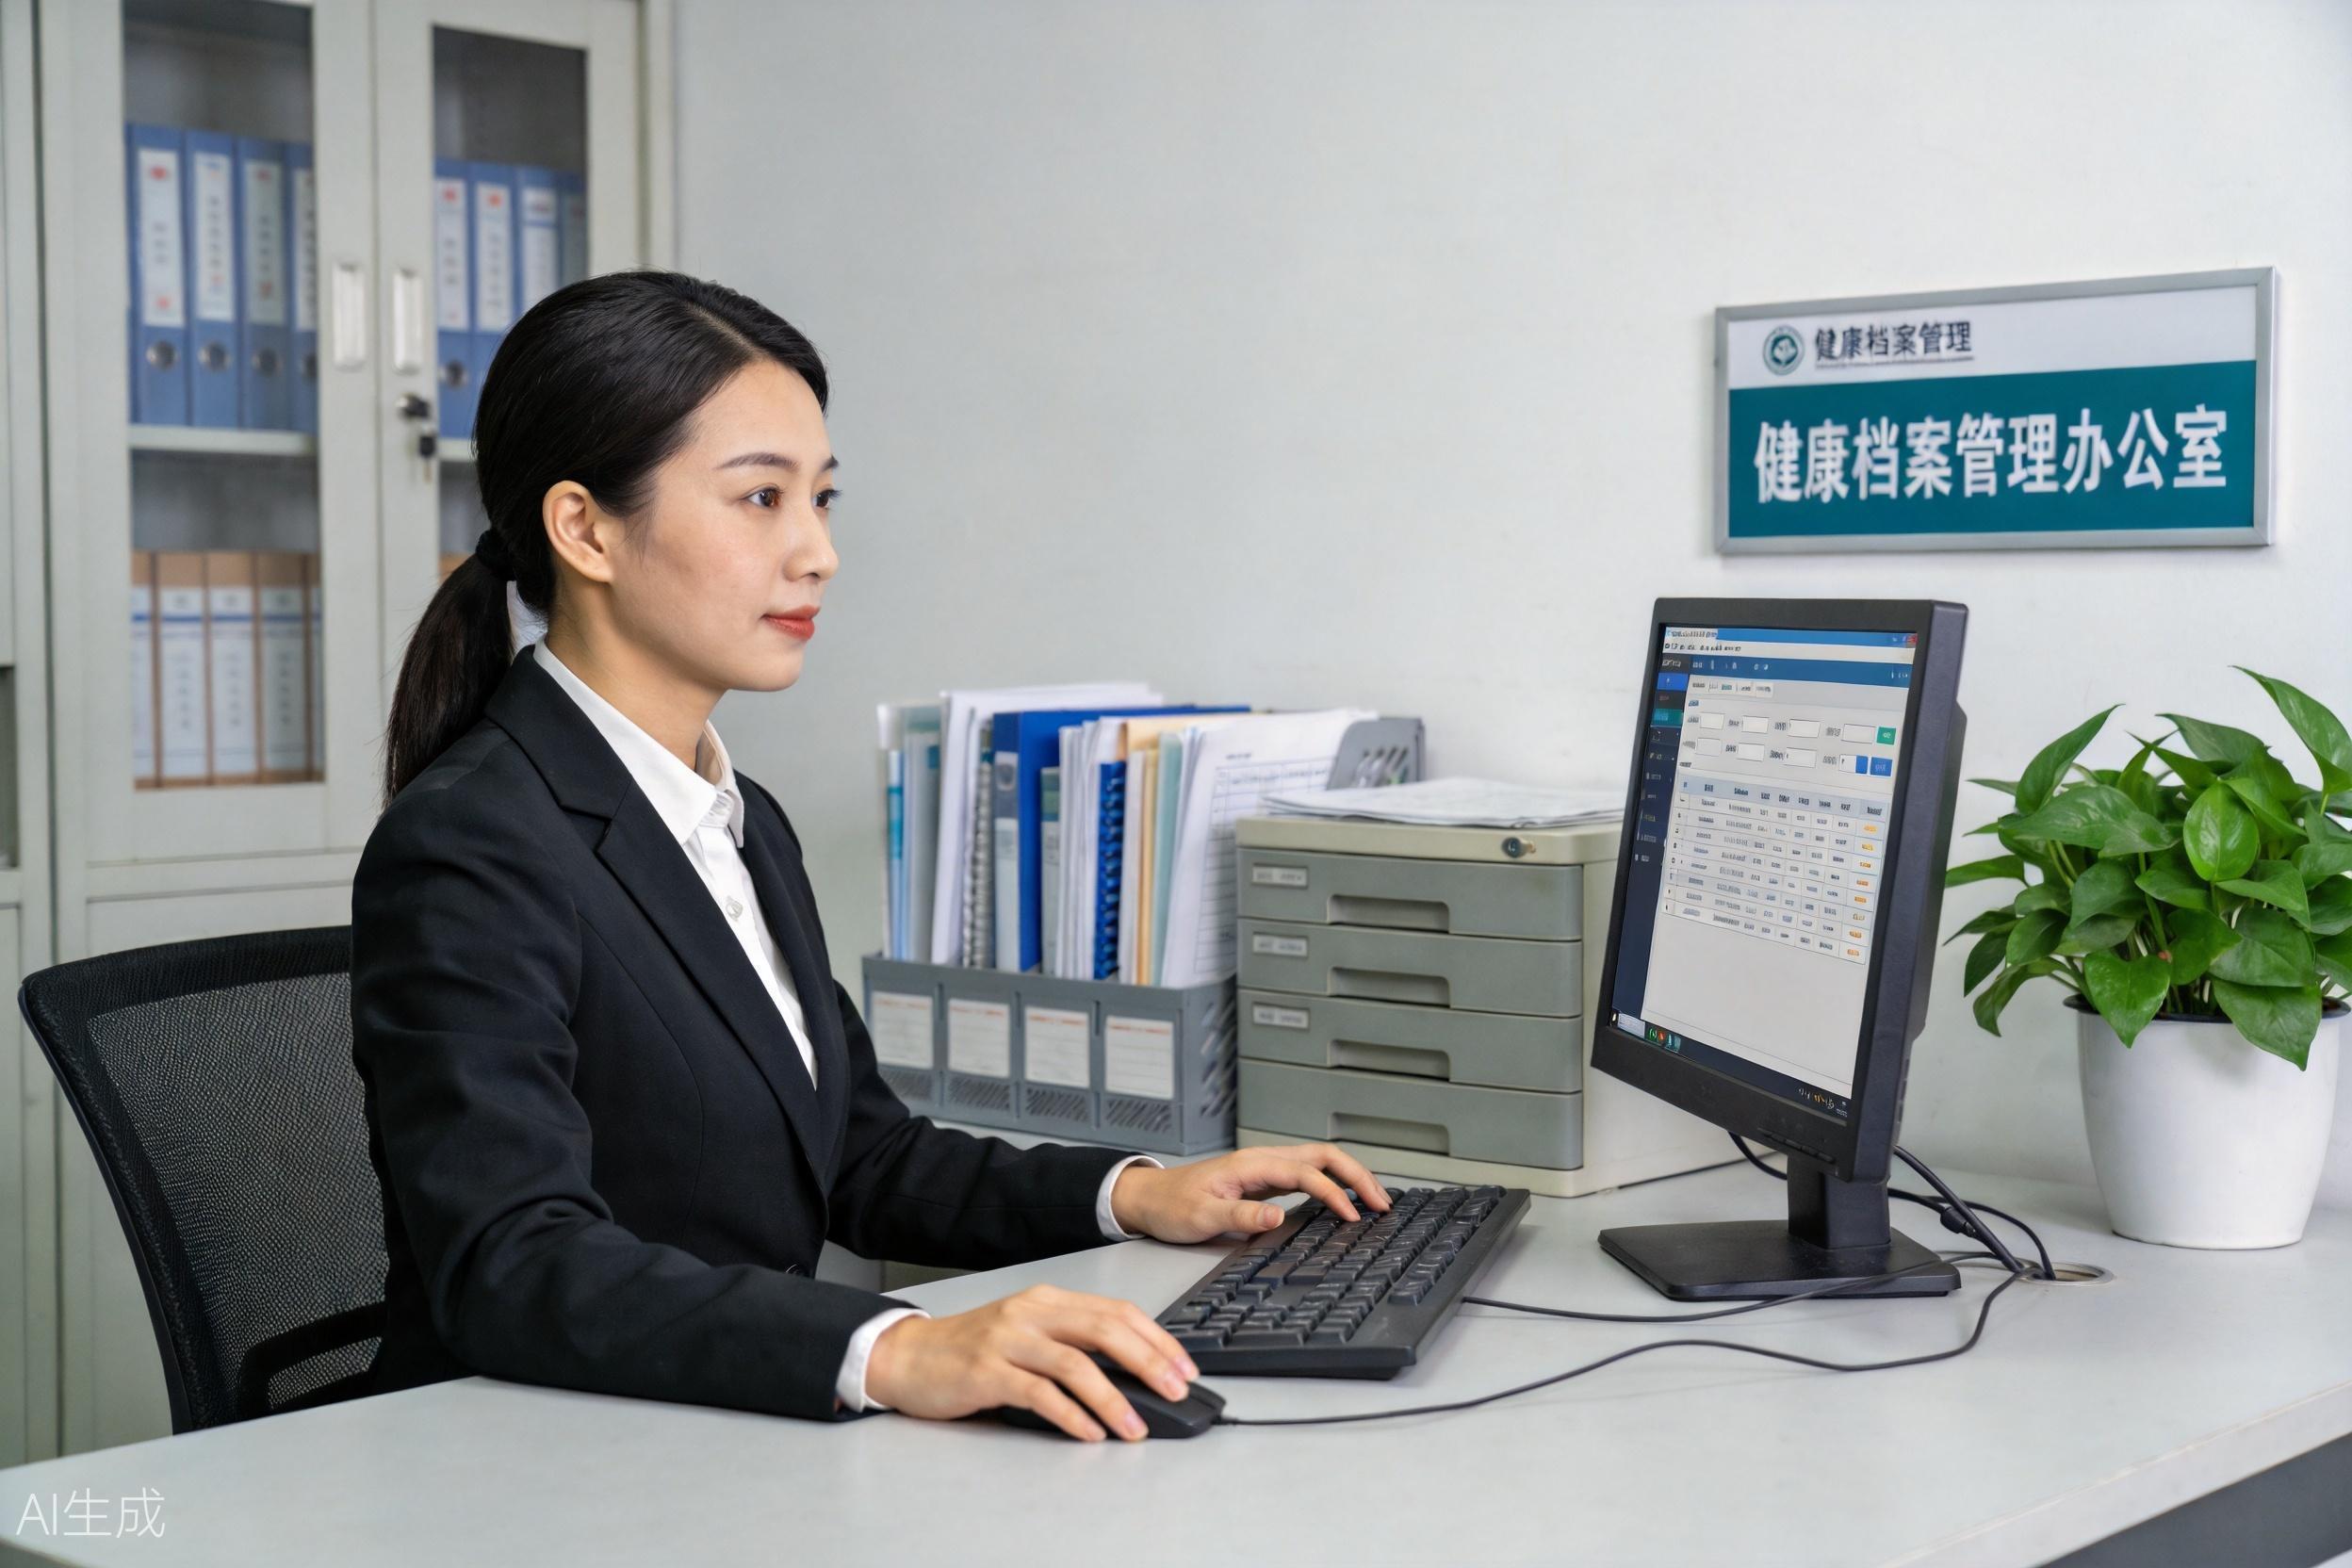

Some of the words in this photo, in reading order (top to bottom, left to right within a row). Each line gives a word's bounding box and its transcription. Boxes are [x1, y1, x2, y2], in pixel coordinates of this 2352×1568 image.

[1815, 320, 1972, 361] 健康档案管理
[1754, 403, 2228, 503] 健康档案管理办公室
